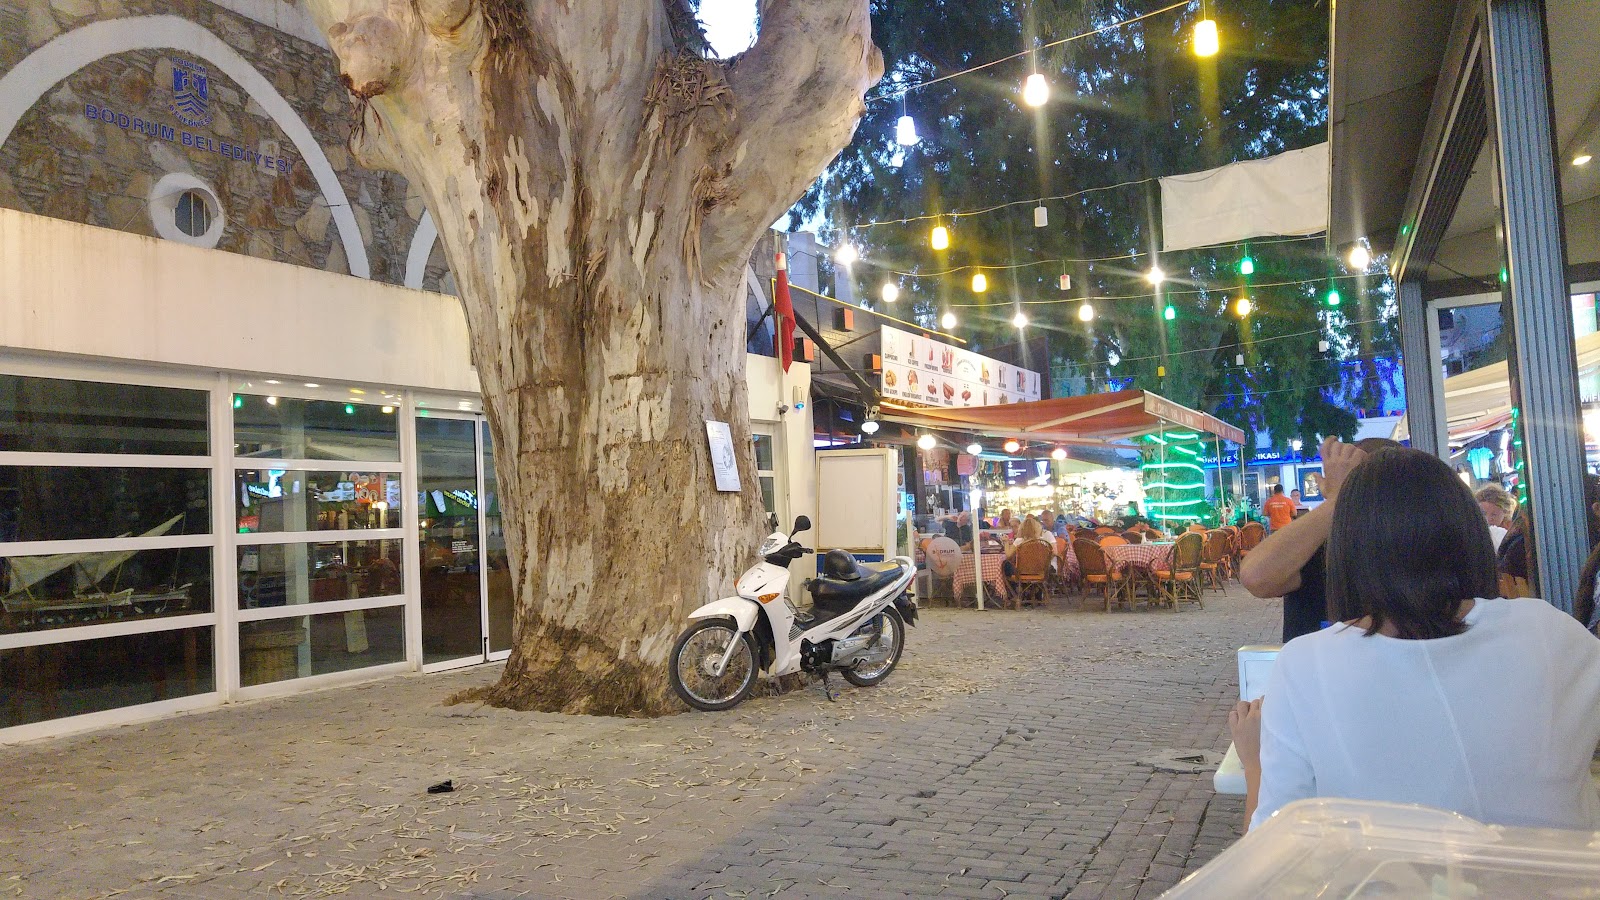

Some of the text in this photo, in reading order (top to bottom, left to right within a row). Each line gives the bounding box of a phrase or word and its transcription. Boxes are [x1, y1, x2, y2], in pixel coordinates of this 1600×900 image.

[172, 57, 206, 73] BODRUM
[84, 103, 292, 174] BODRUM BELEDİYESİ
